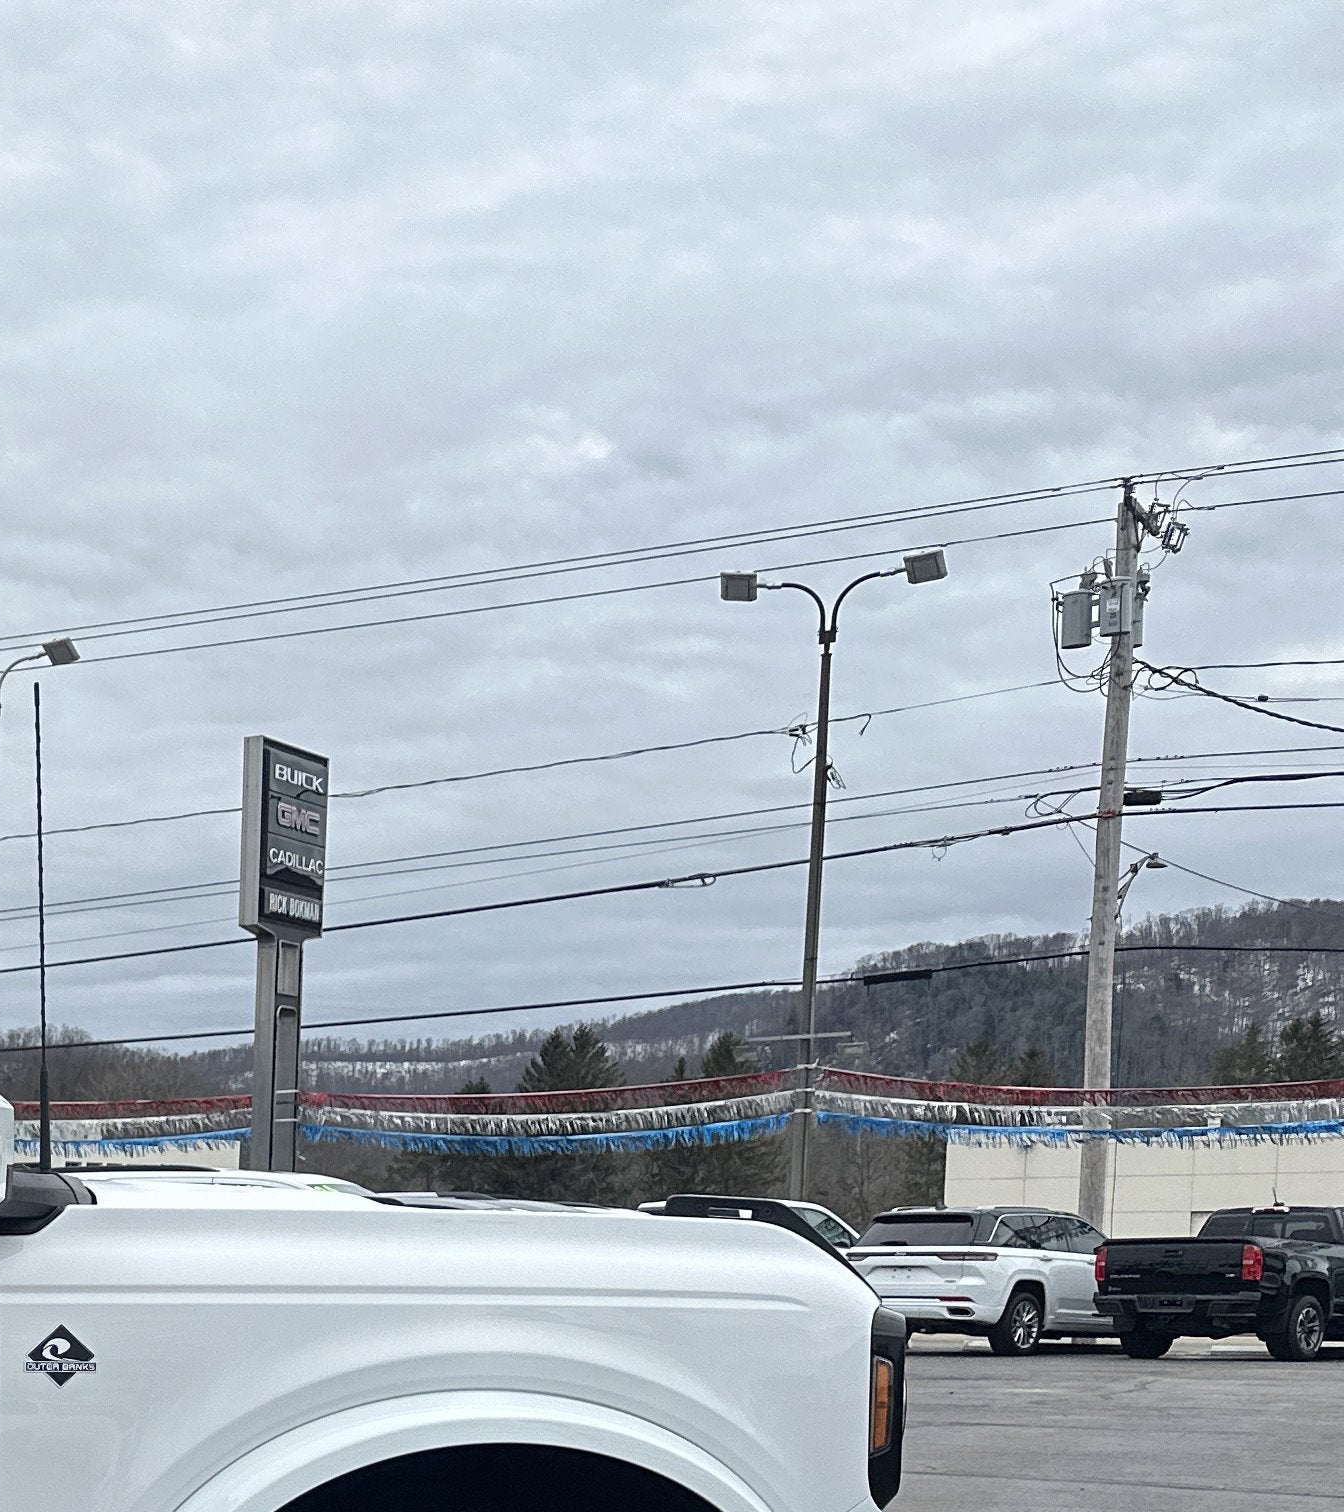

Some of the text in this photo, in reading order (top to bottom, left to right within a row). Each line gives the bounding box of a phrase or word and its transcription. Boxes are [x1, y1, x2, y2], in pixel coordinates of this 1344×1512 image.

[275, 763, 324, 793] BUICK
[277, 802, 320, 836] GMC
[269, 847, 323, 874] CADILLAC
